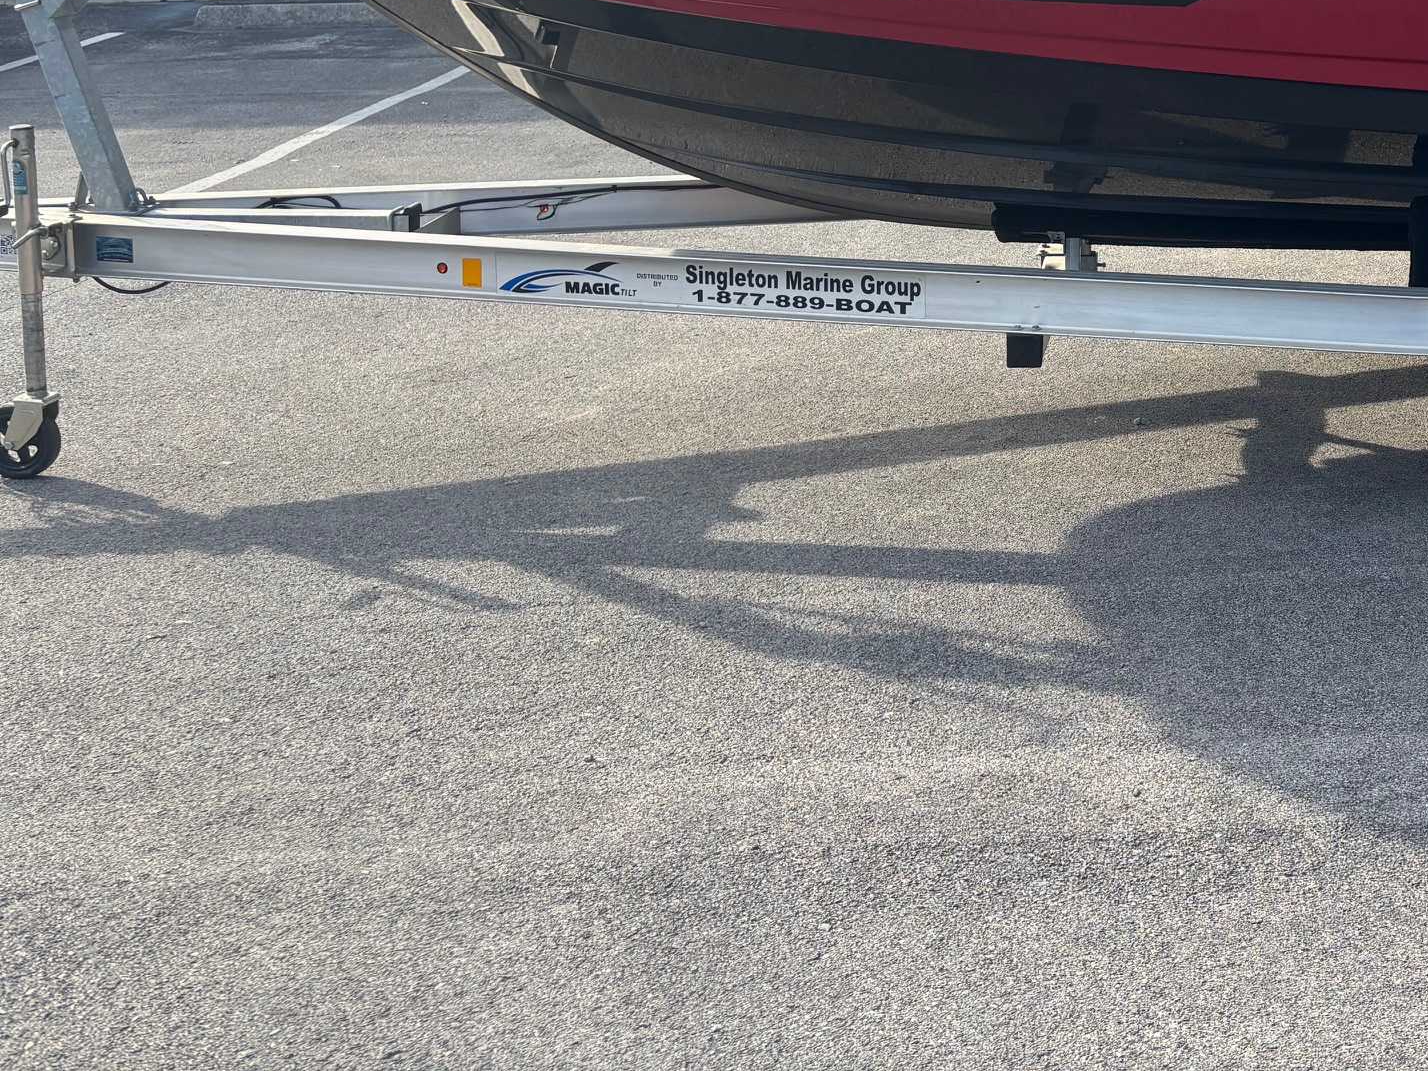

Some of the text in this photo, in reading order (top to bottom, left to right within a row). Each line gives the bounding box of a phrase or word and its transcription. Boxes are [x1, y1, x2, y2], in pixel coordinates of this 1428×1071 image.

[565, 280, 637, 297] MAGIC TILT
[685, 264, 922, 302] Singleton Marine Group
[692, 289, 913, 315] 1-877-889-BOAT
